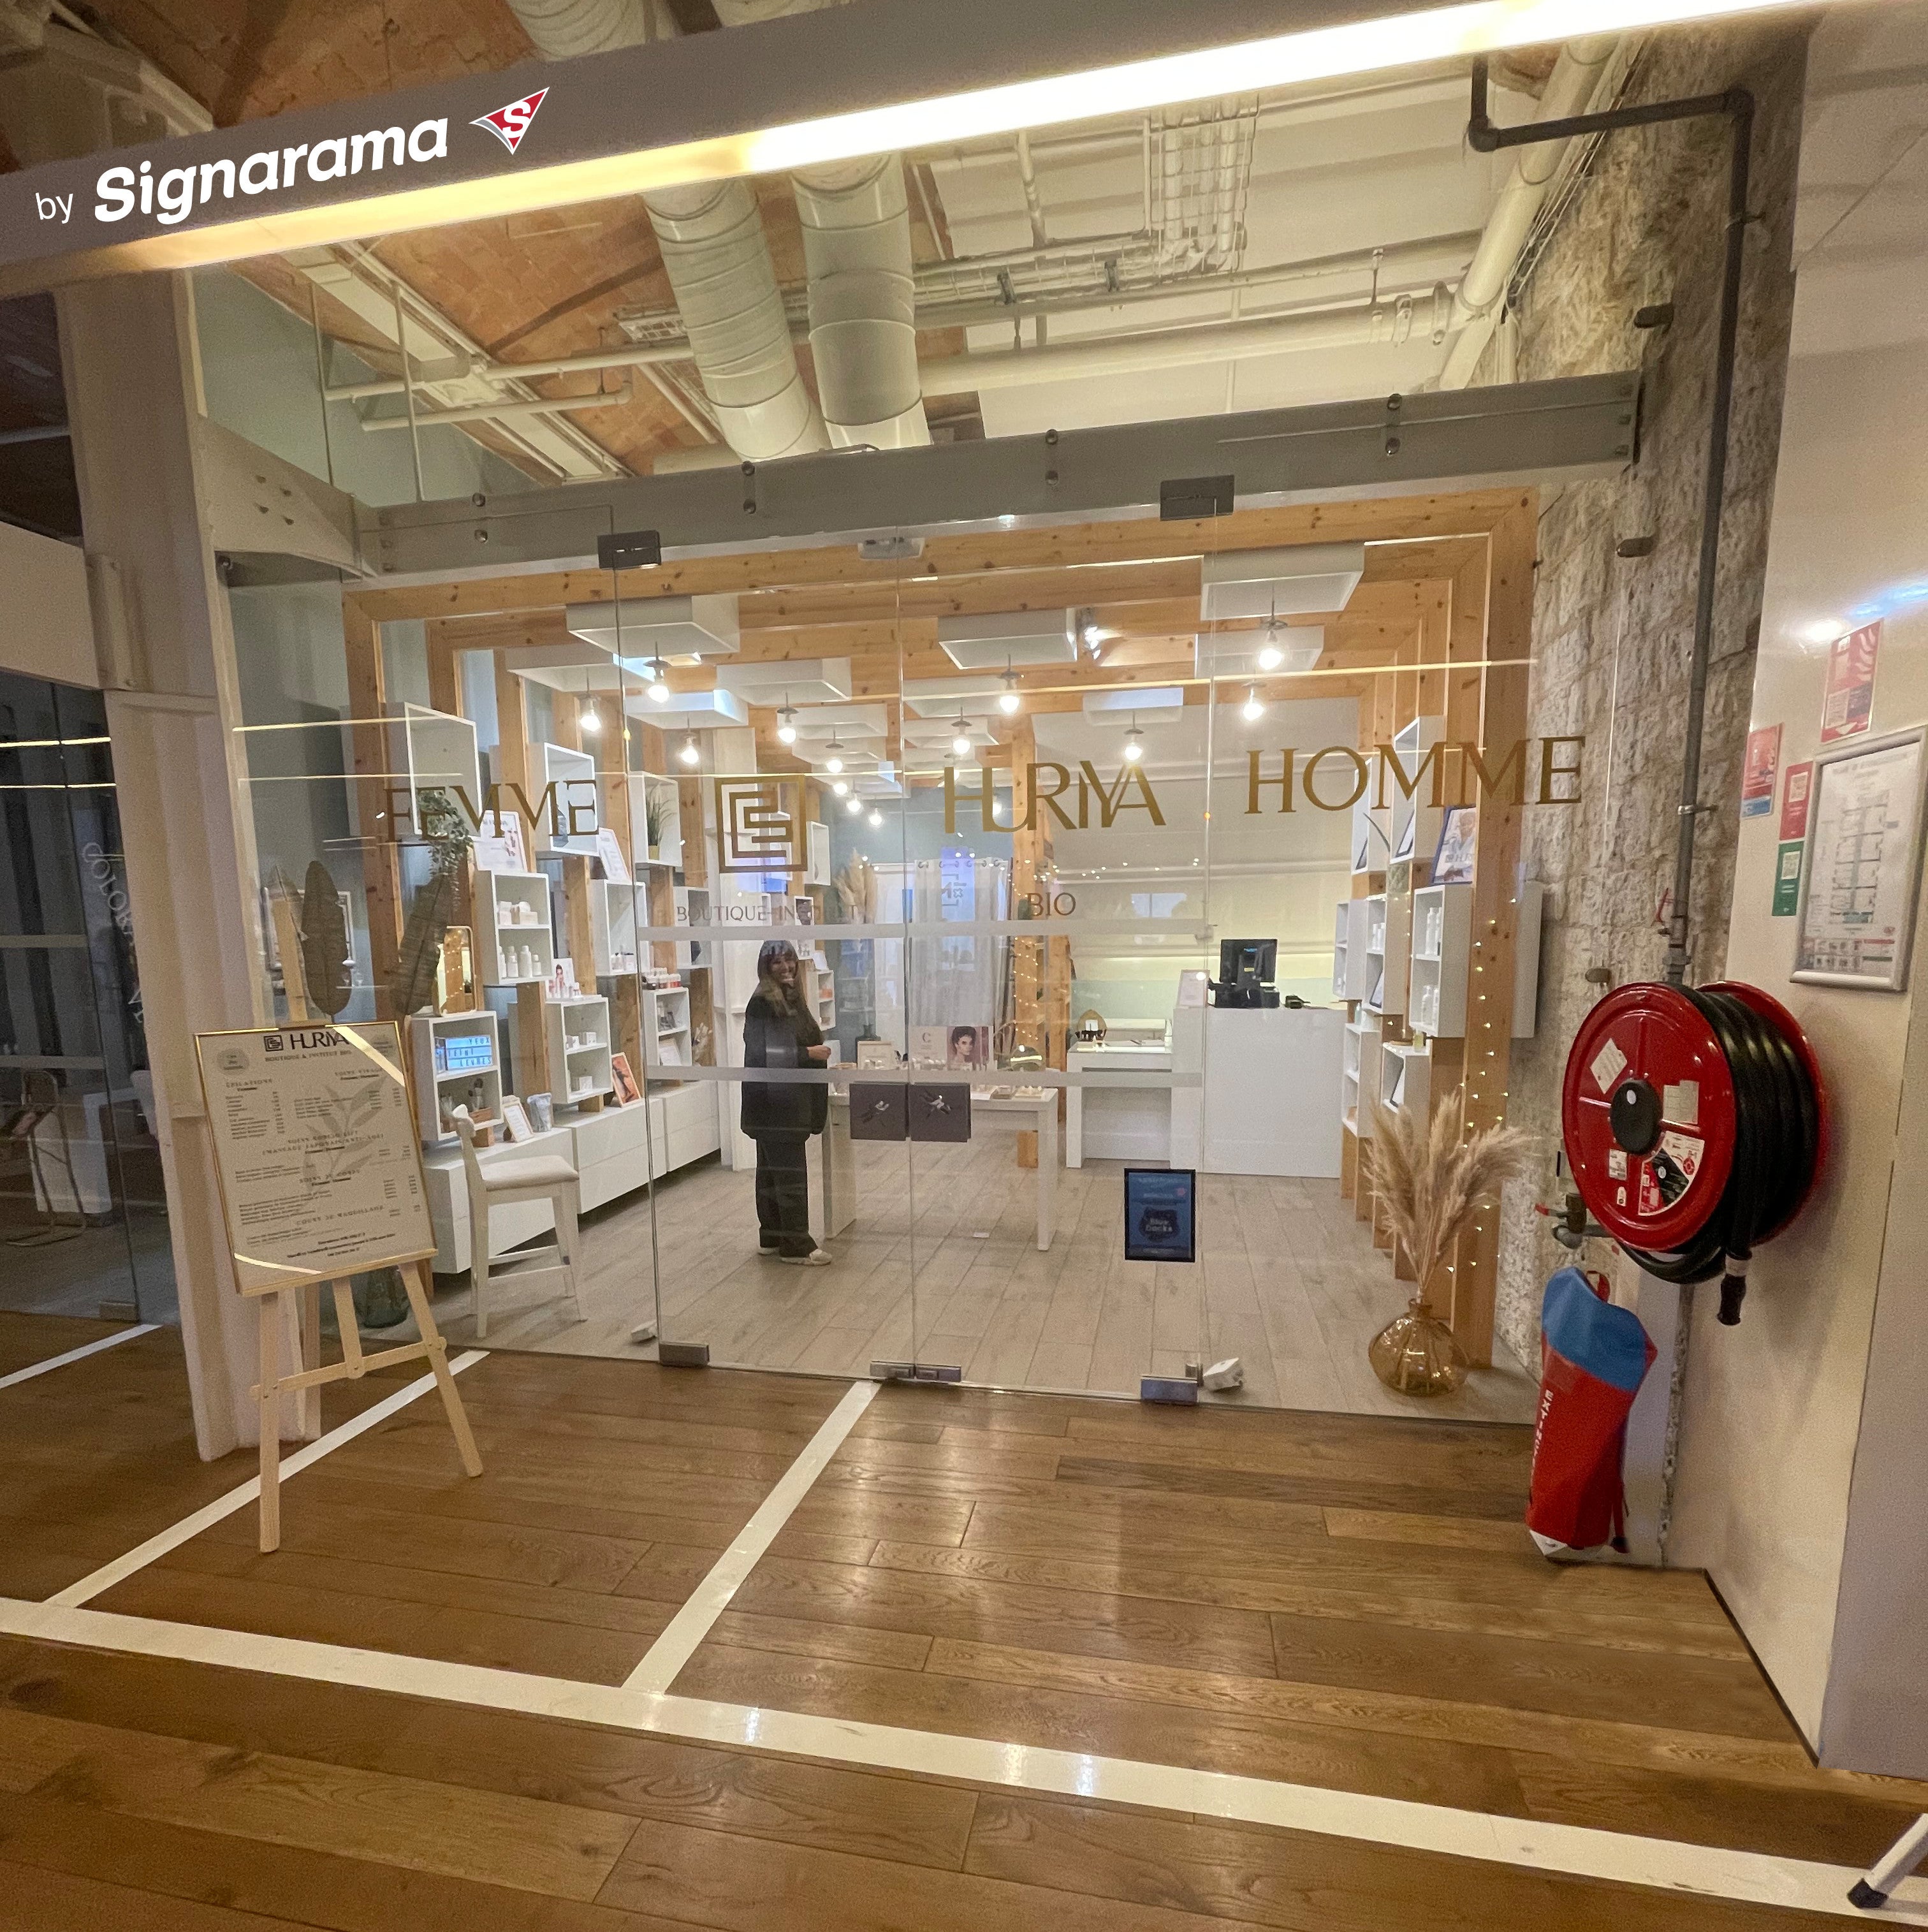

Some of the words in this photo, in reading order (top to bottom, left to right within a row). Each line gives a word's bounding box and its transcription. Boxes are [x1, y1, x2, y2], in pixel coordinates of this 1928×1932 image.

[383, 779, 599, 842] FEMME
[1245, 736, 1586, 814] HOMME
[1027, 892, 1076, 916] BIO
